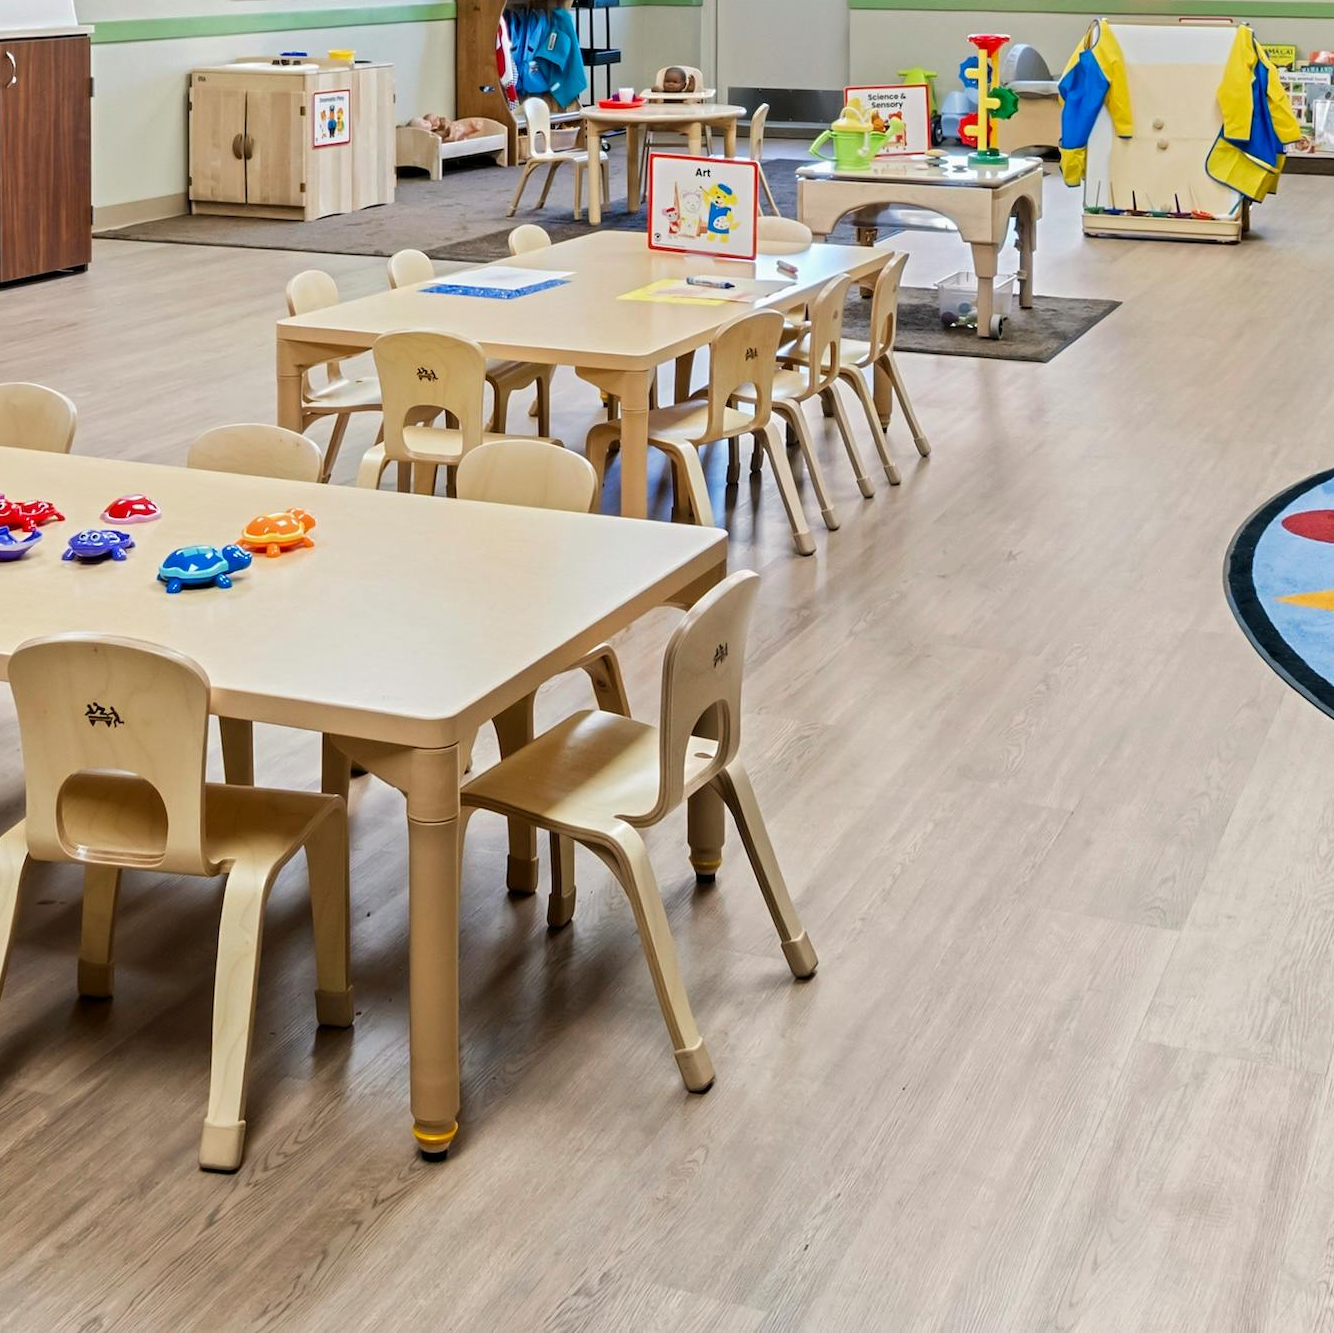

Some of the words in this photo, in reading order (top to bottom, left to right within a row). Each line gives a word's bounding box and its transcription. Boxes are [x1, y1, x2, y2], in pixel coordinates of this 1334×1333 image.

[868, 93, 899, 101] Science
[871, 101, 903, 109] Sensory
[695, 168, 711, 177] Art
